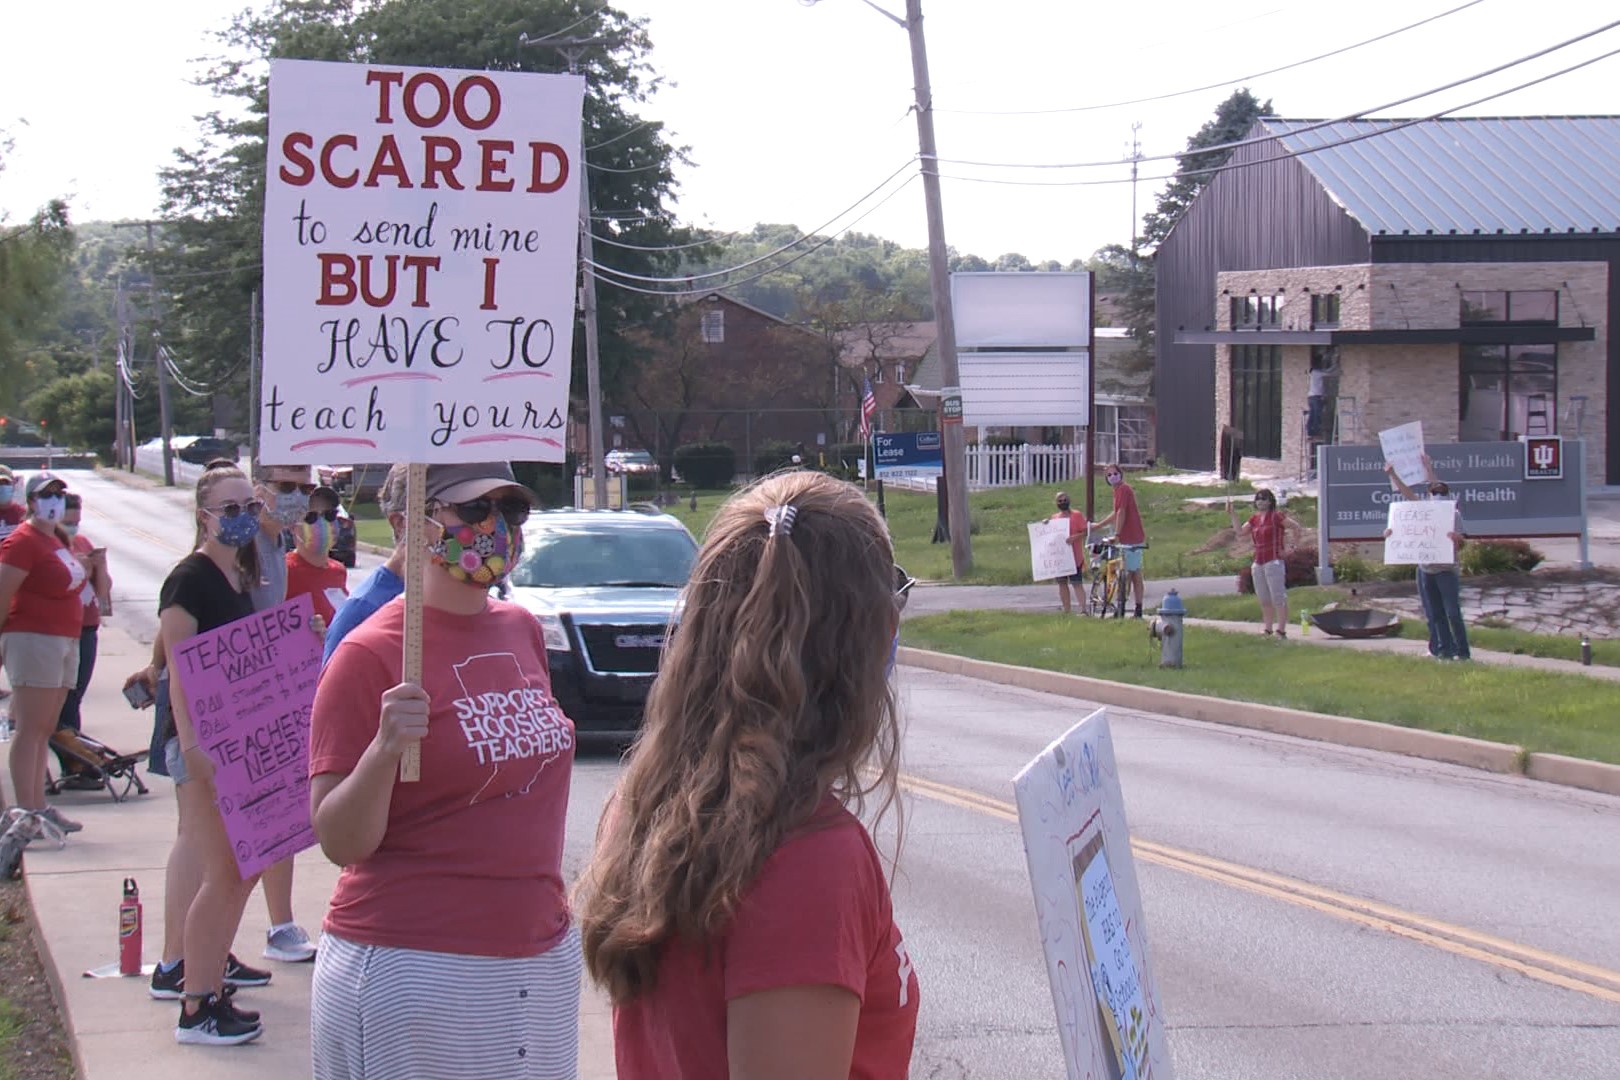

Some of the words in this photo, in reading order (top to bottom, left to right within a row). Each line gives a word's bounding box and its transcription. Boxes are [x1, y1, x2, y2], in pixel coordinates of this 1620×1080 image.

[366, 70, 501, 130] TOO
[279, 131, 569, 193] SCARED
[293, 199, 326, 245] to
[353, 202, 436, 248] send
[451, 222, 539, 252] mine
[315, 253, 441, 308] BUT
[479, 258, 499, 310] I
[317, 314, 464, 373] HAVE
[486, 316, 554, 370] TO
[265, 385, 386, 432] teach
[431, 400, 565, 447] yours
[877, 437, 893, 447] For
[877, 448, 904, 457] Lease
[1337, 457, 1383, 472] Indian
[1467, 453, 1515, 469] Health
[1336, 511, 1353, 521] 333
[1354, 511, 1361, 521] E
[1362, 510, 1387, 521] Mille
[1465, 487, 1516, 502] Health
[180, 605, 301, 674] TEACHERS
[452, 688, 550, 720] SUPPORT
[460, 707, 568, 742] HOOSIER
[209, 704, 312, 767] TEACHERS
[468, 727, 571, 765] TEACHERS
